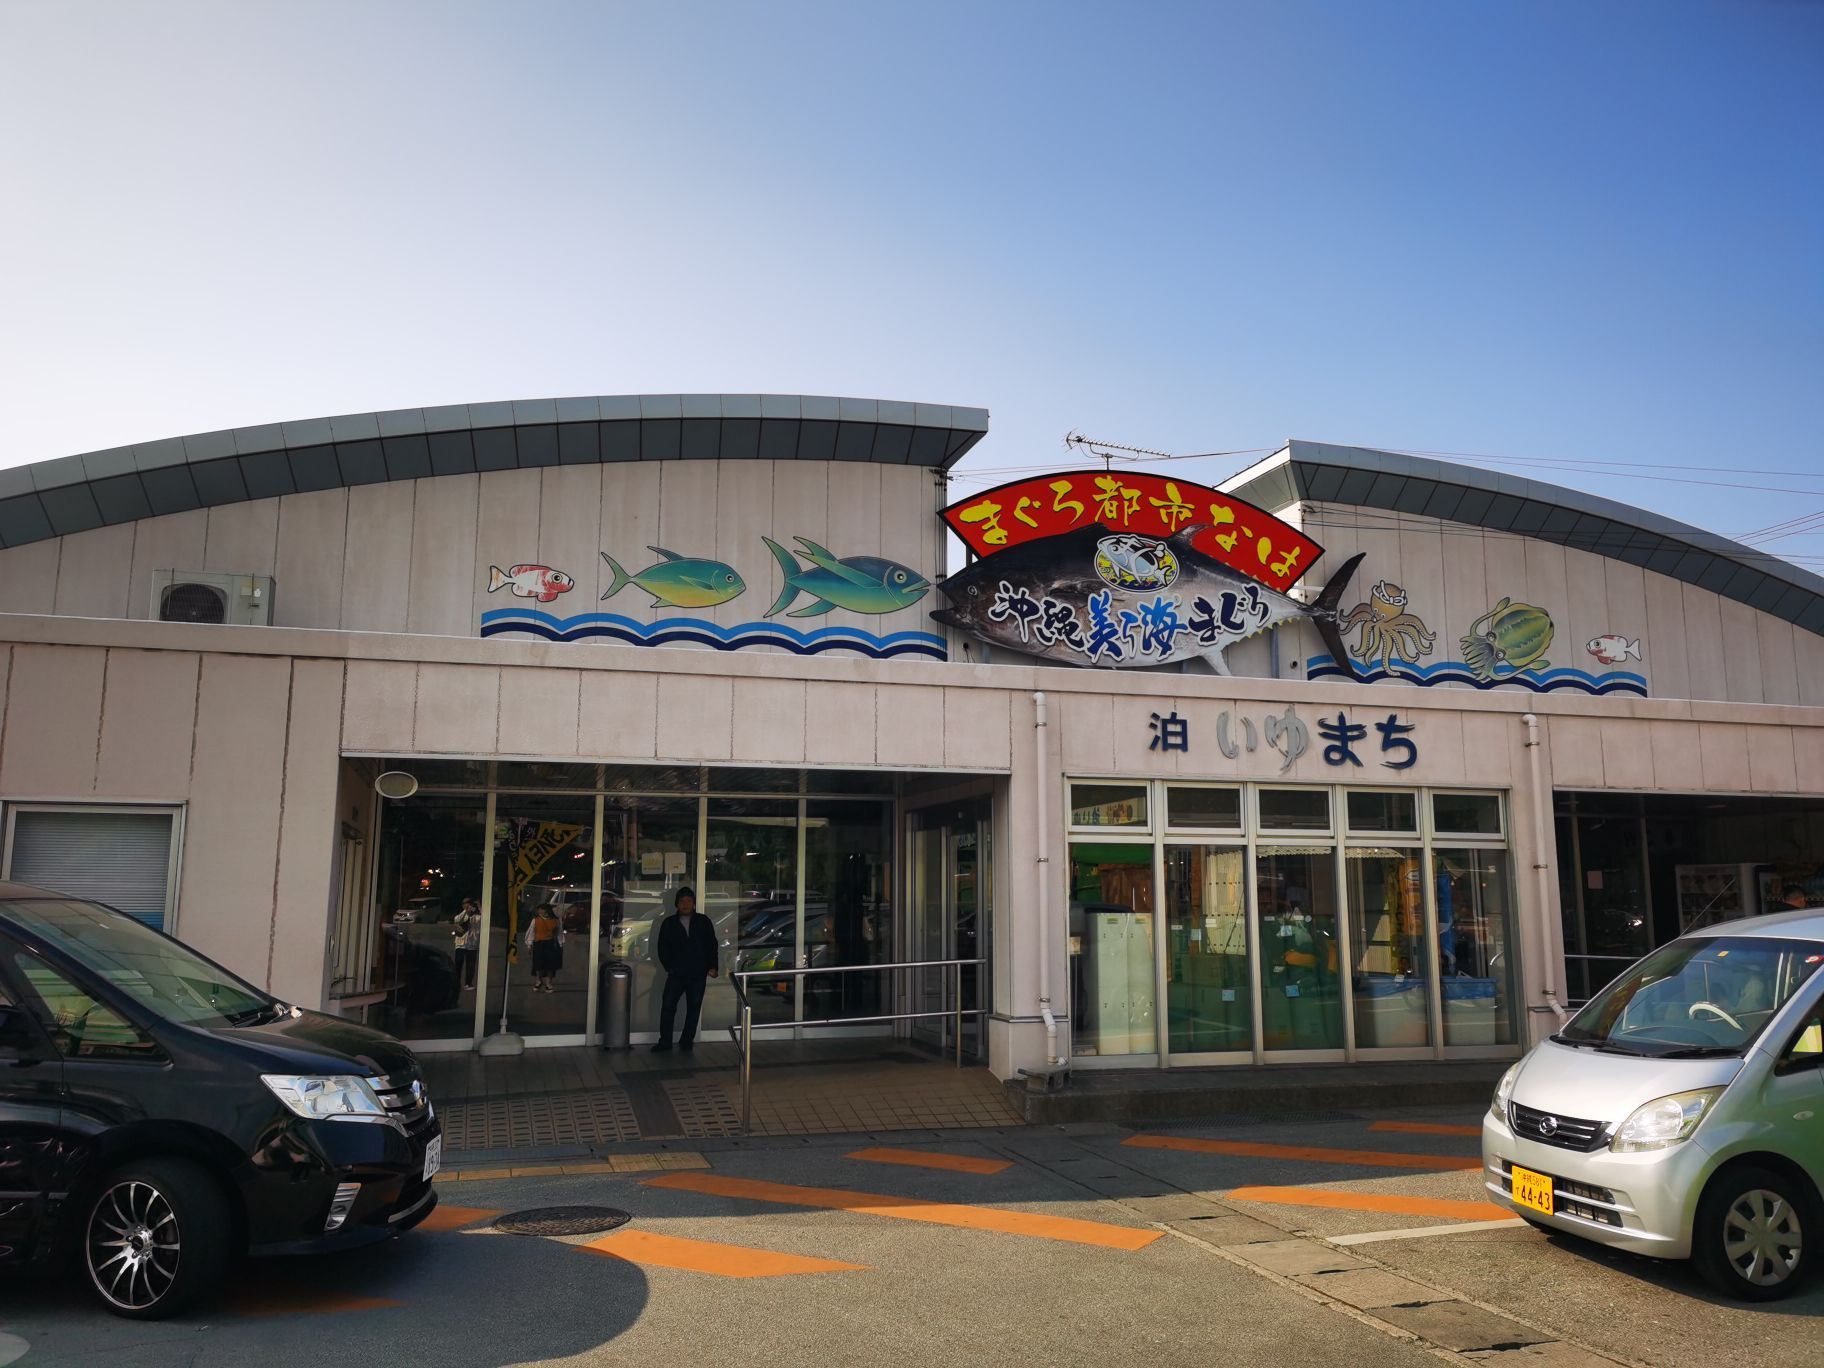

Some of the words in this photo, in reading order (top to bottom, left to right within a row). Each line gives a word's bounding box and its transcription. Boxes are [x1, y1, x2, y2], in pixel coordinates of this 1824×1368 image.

[959, 475, 1301, 578] まぐろ都市なは
[989, 581, 1272, 663] 沖縄美ら海まぐろ
[1149, 711, 1188, 752] 泊
[1216, 704, 1418, 775] いゆまち
